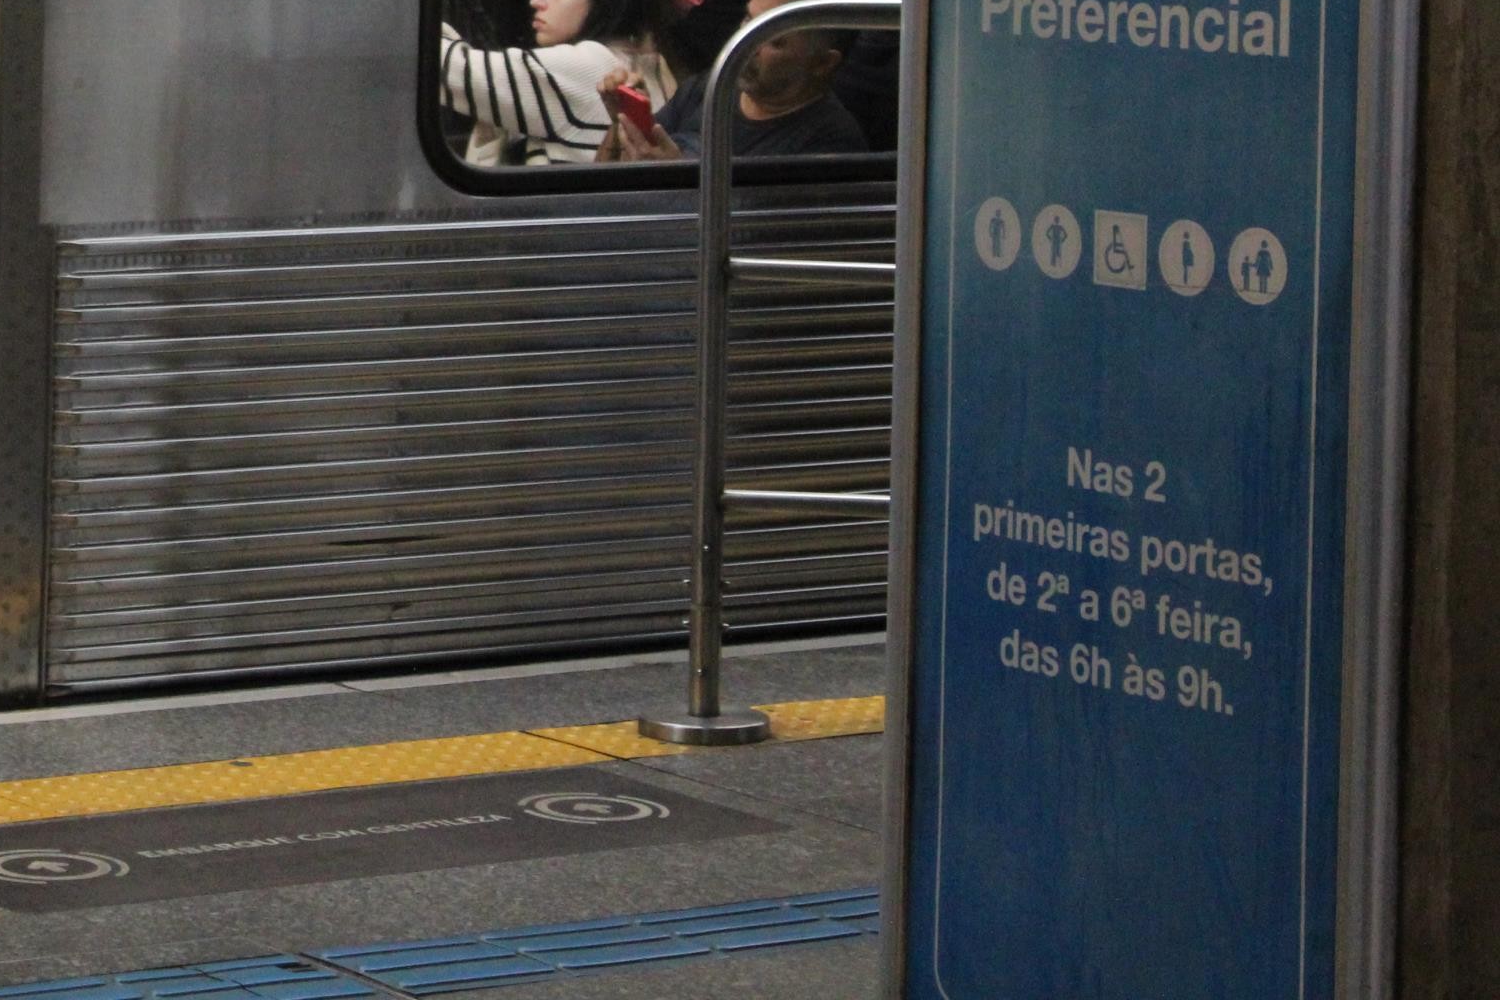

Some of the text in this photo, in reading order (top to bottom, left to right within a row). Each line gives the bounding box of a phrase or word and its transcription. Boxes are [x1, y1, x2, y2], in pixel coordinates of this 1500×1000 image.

[1067, 446, 1167, 503] Nas 2
[973, 499, 1273, 596] primeiras portas,
[987, 562, 1027, 606] de
[1079, 588, 1099, 621] a
[1156, 594, 1252, 660] feira,
[1000, 629, 1234, 716] das 6h às 9h.
[136, 813, 512, 859] EMBARQUE COM GENTILEZA
